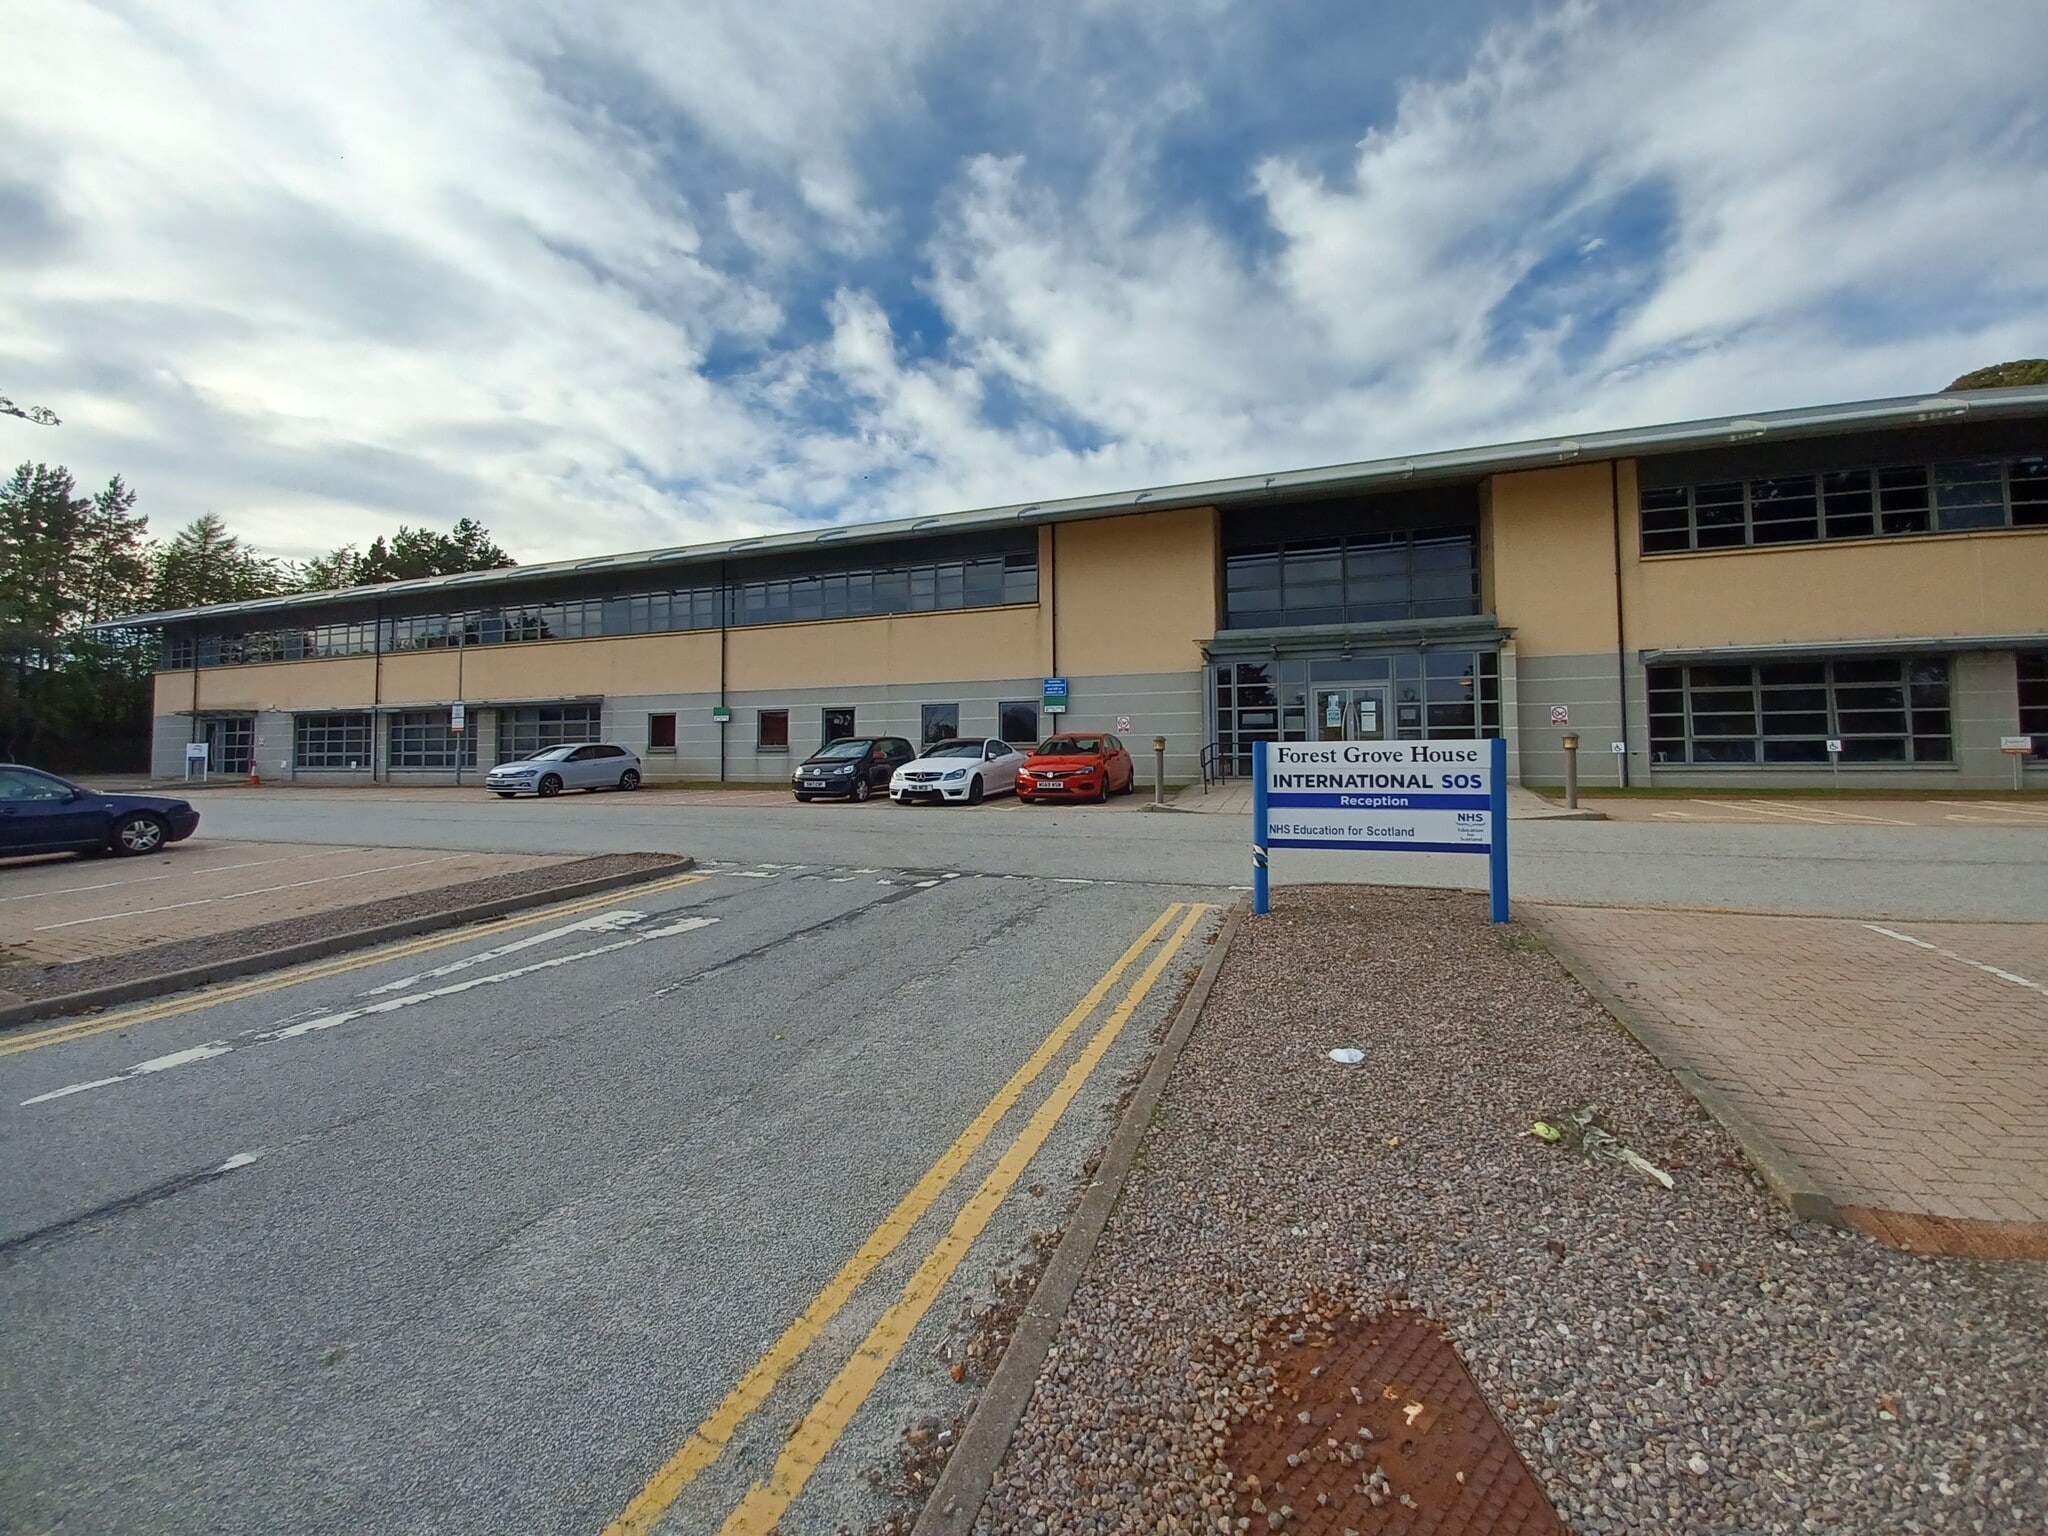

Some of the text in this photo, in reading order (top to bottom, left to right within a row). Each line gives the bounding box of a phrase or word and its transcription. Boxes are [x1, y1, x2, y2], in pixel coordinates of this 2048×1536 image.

[1277, 745, 1478, 763] Forest Grove House
[1273, 774, 1483, 789] INTERNATIONAL SOS
[1340, 795, 1409, 808] Reception
[1457, 813, 1484, 822] NHS
[1269, 823, 1415, 837] NHS Education for Scotland
